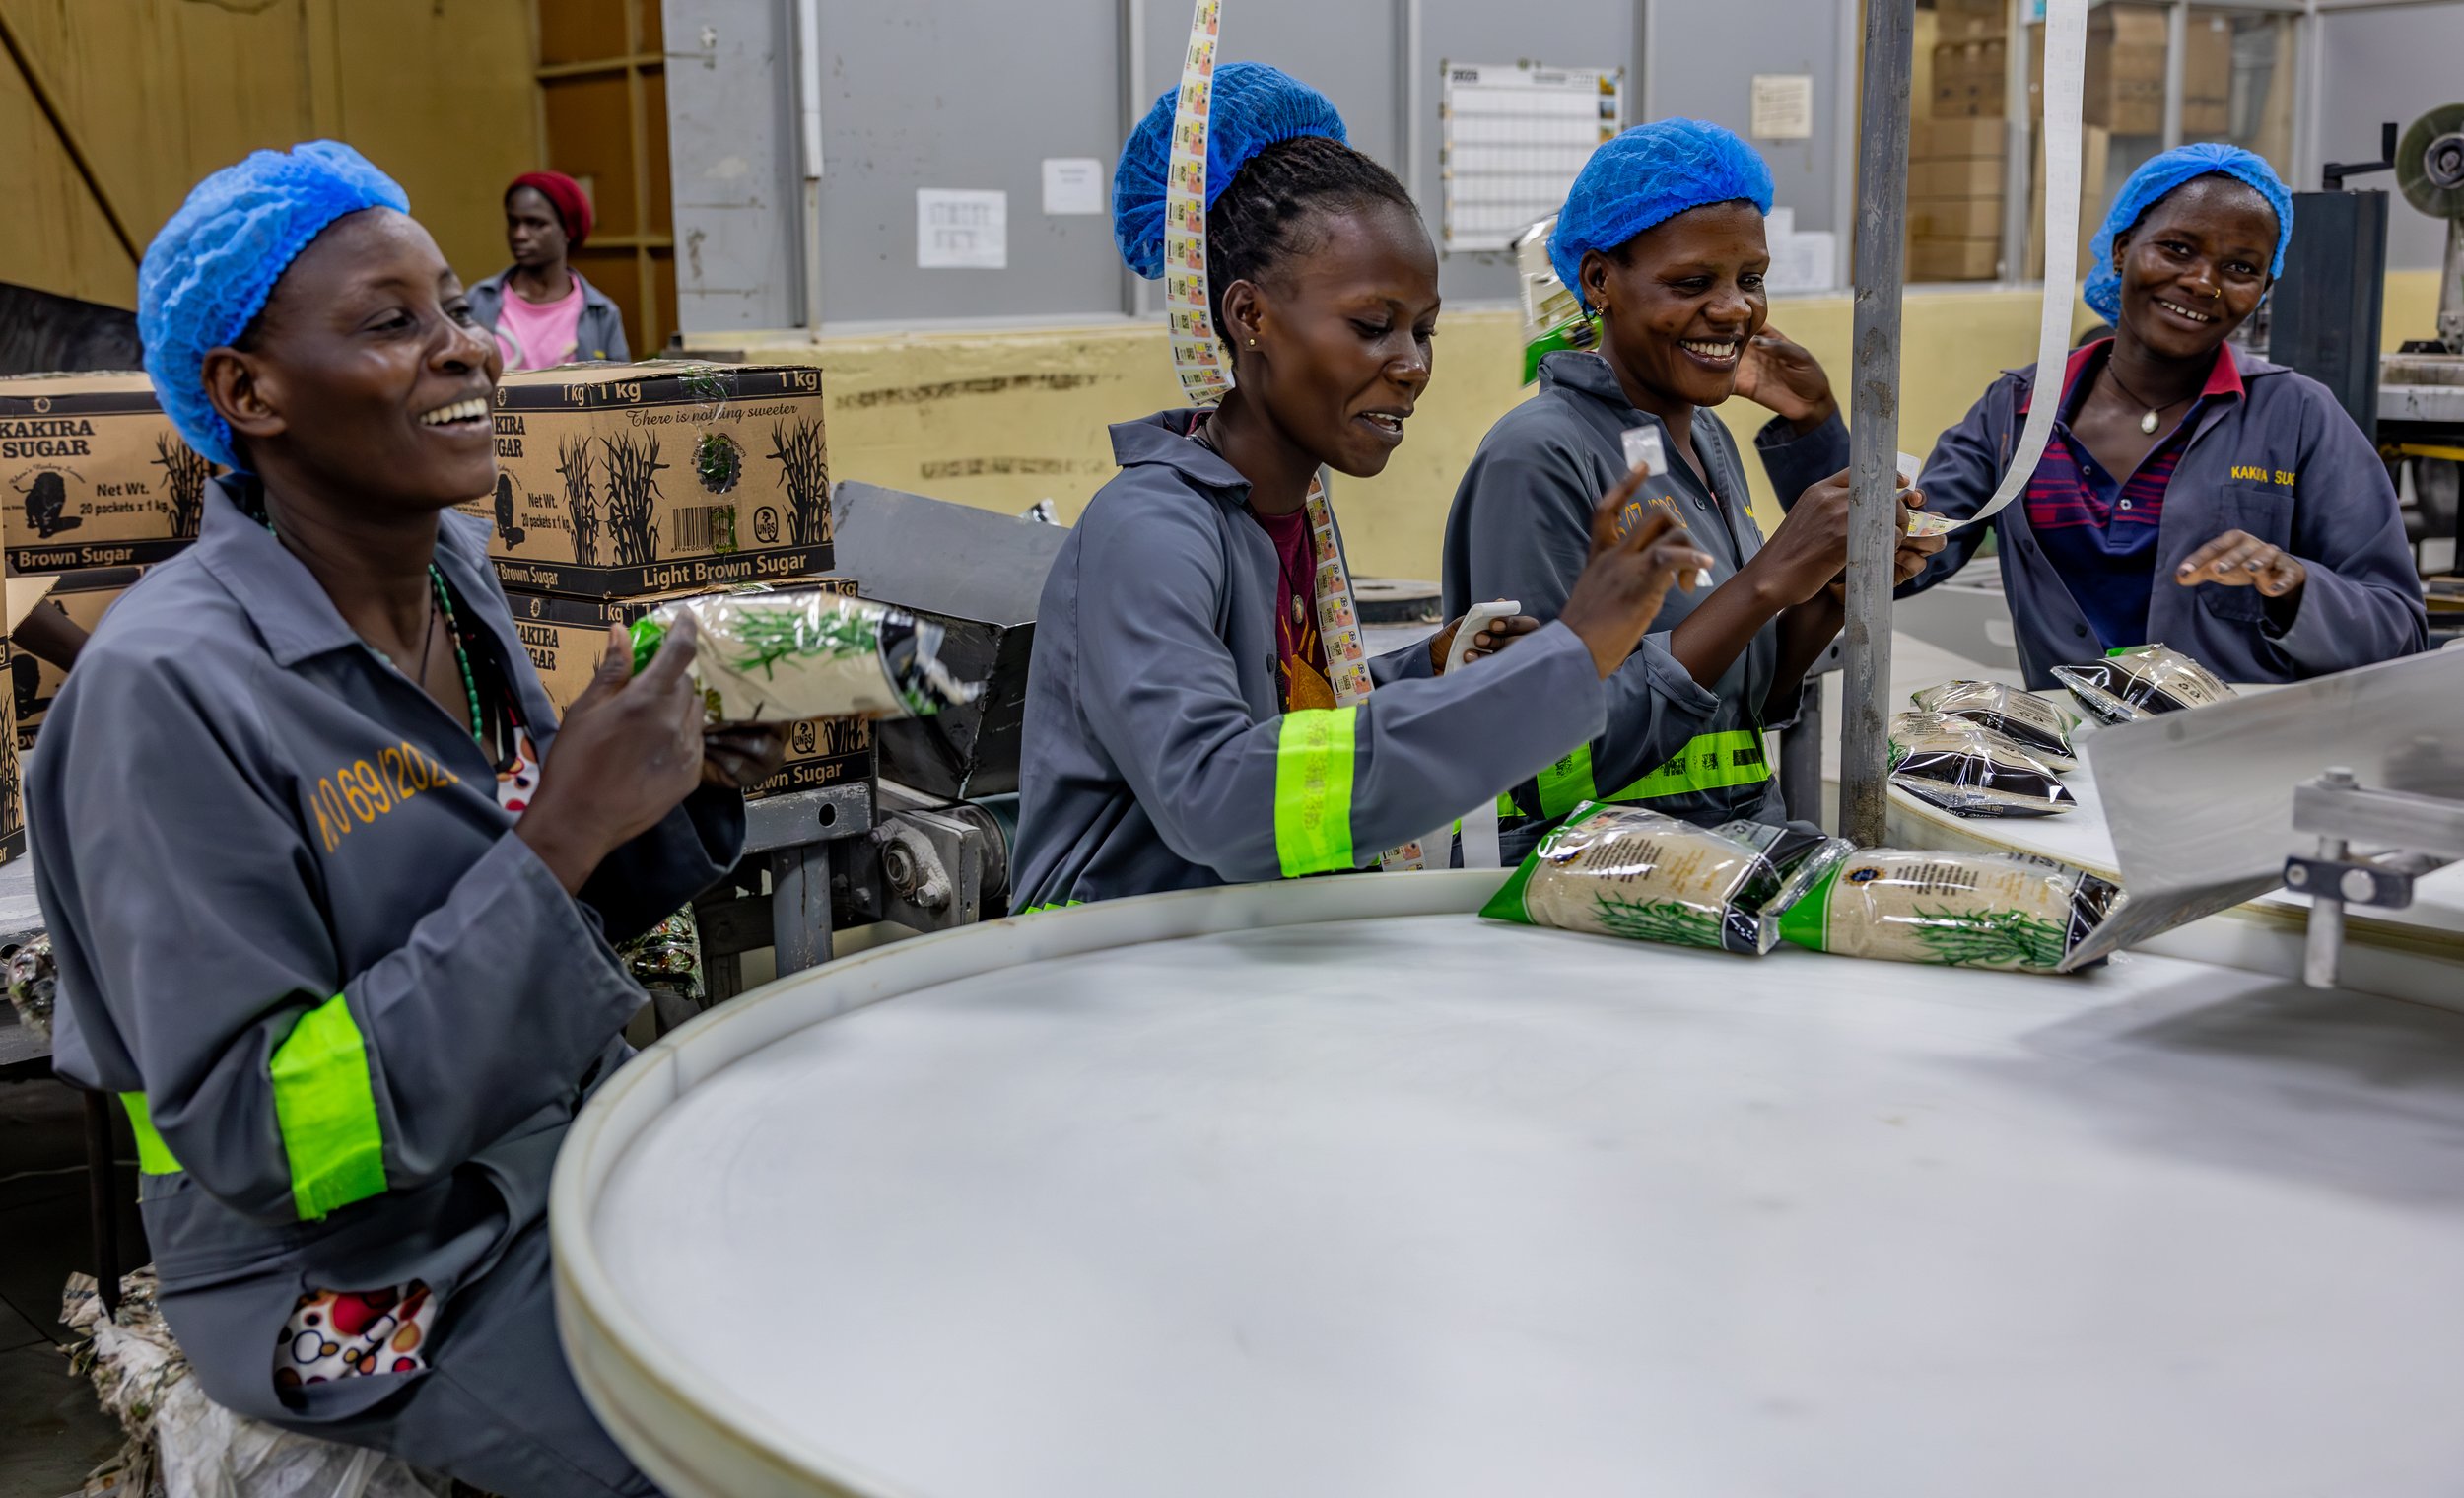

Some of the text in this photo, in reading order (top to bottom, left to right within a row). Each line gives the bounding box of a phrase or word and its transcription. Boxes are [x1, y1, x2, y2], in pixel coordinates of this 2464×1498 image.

[779, 371, 818, 390] 1 kg
[563, 384, 584, 406] 1 kg
[601, 383, 641, 402] 1 kg
[626, 403, 798, 427] There is nothing sweeter
[0, 420, 95, 439] KAKIRA
[494, 416, 526, 435] KIRA
[3, 440, 91, 459] SUGAR
[494, 439, 524, 457] GAR
[97, 482, 150, 497] Net Wt.
[80, 503, 93, 514] 20
[96, 501, 134, 516] packets
[137, 504, 144, 512] x
[528, 493, 543, 508] Net
[521, 512, 528, 528] 20
[530, 514, 551, 531] packets
[756, 521, 776, 535] UNBS
[19, 551, 77, 568] Brown
[82, 547, 133, 564] Sugar
[500, 563, 530, 583] Brown
[530, 566, 559, 589] Sugar
[643, 553, 807, 589] Light Brown Sugar
[598, 604, 604, 620] 1
[607, 604, 624, 623] kg
[528, 647, 556, 671] GAR
[793, 763, 843, 785] Sugar
